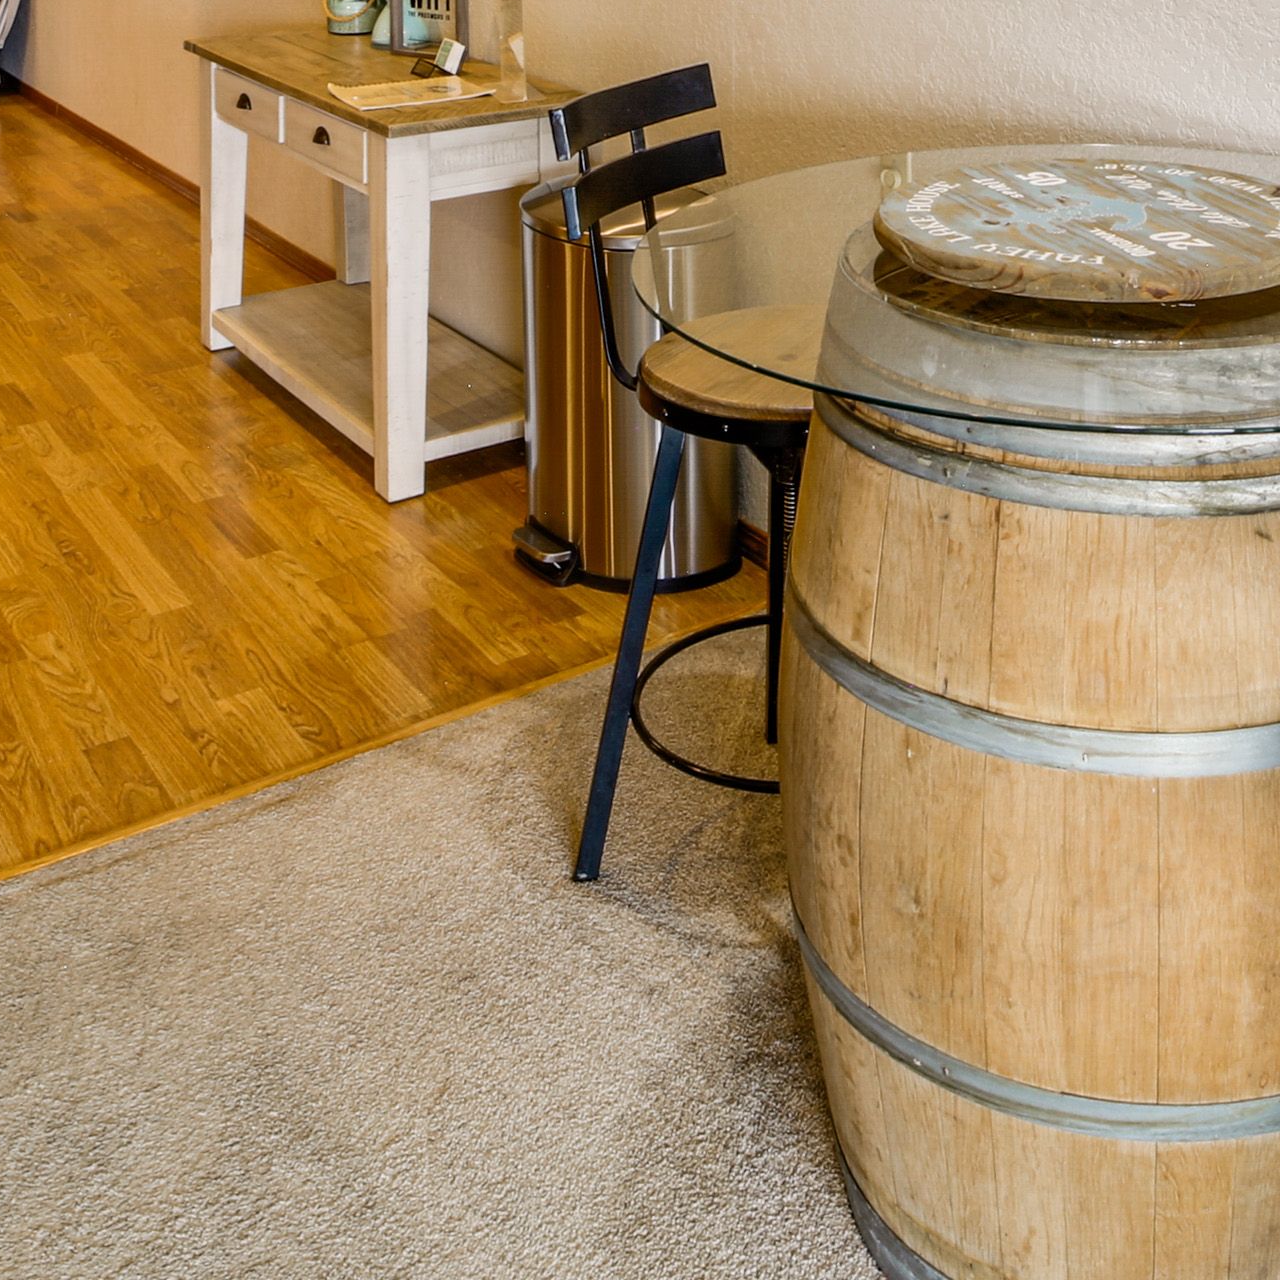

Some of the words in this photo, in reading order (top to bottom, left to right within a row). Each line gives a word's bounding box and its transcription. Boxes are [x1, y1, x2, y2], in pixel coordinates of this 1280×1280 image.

[1015, 171, 1068, 187] 05
[905, 179, 962, 213] HOUSE
[908, 214, 973, 244] LAKE
[1089, 226, 1157, 258] ORIGINAL
[1149, 231, 1216, 251] 20
[972, 242, 1106, 266] FAHEY
